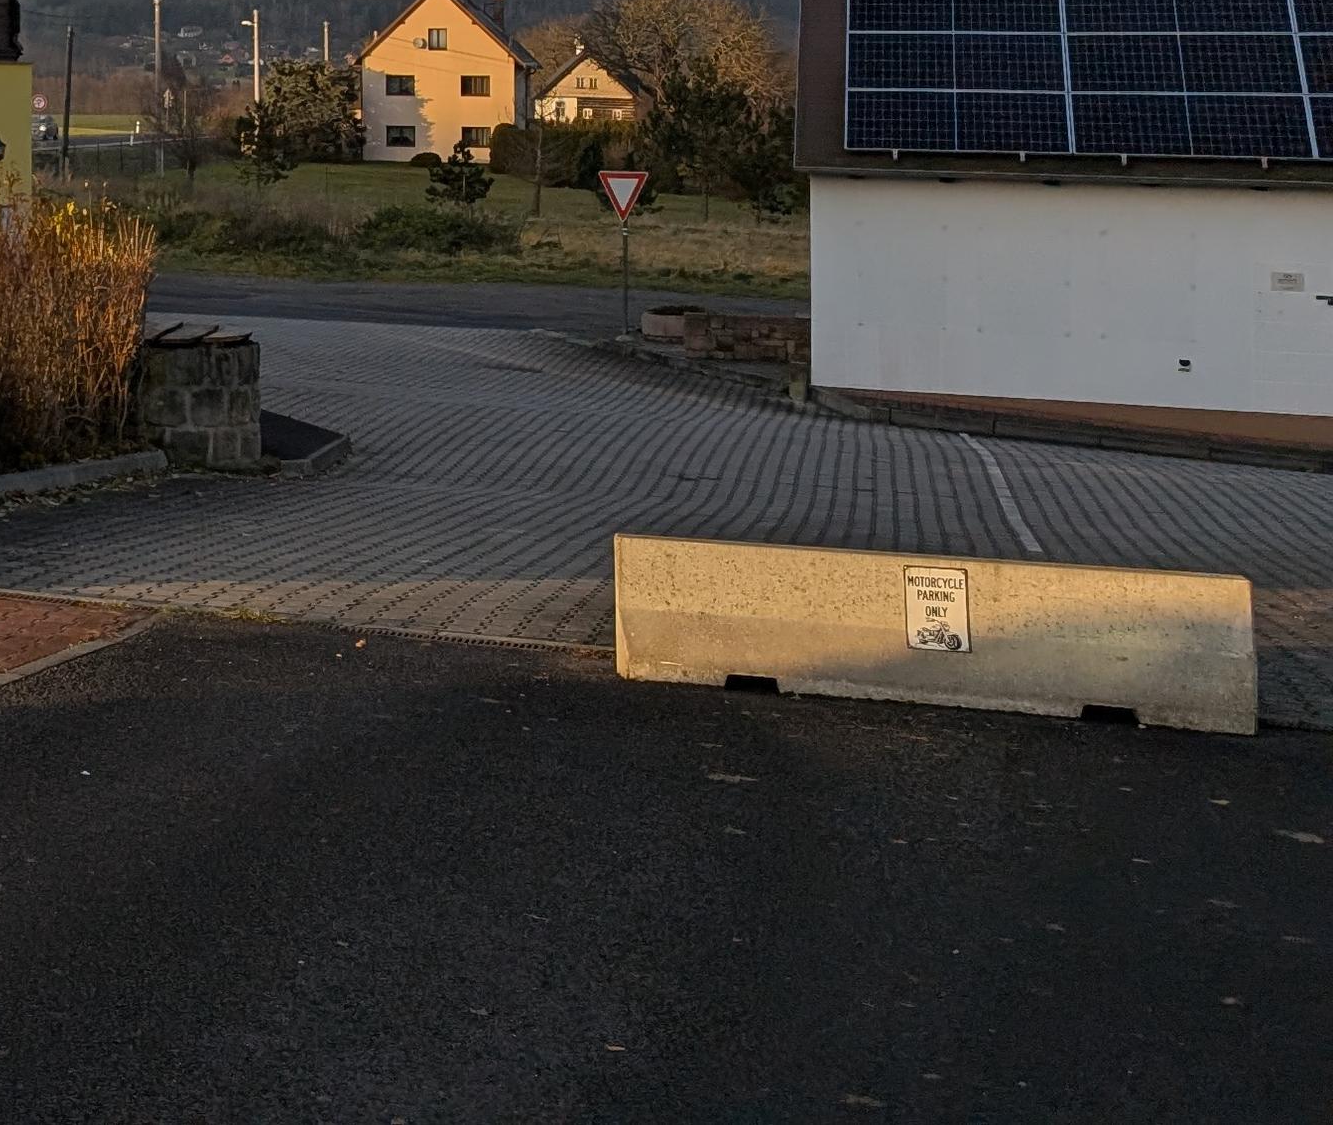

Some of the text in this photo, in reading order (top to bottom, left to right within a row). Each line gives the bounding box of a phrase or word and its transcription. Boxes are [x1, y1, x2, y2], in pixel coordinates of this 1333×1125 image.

[907, 575, 964, 590] MOTORCYCLE
[916, 589, 955, 603] PARKING
[925, 605, 948, 618] ONLY
